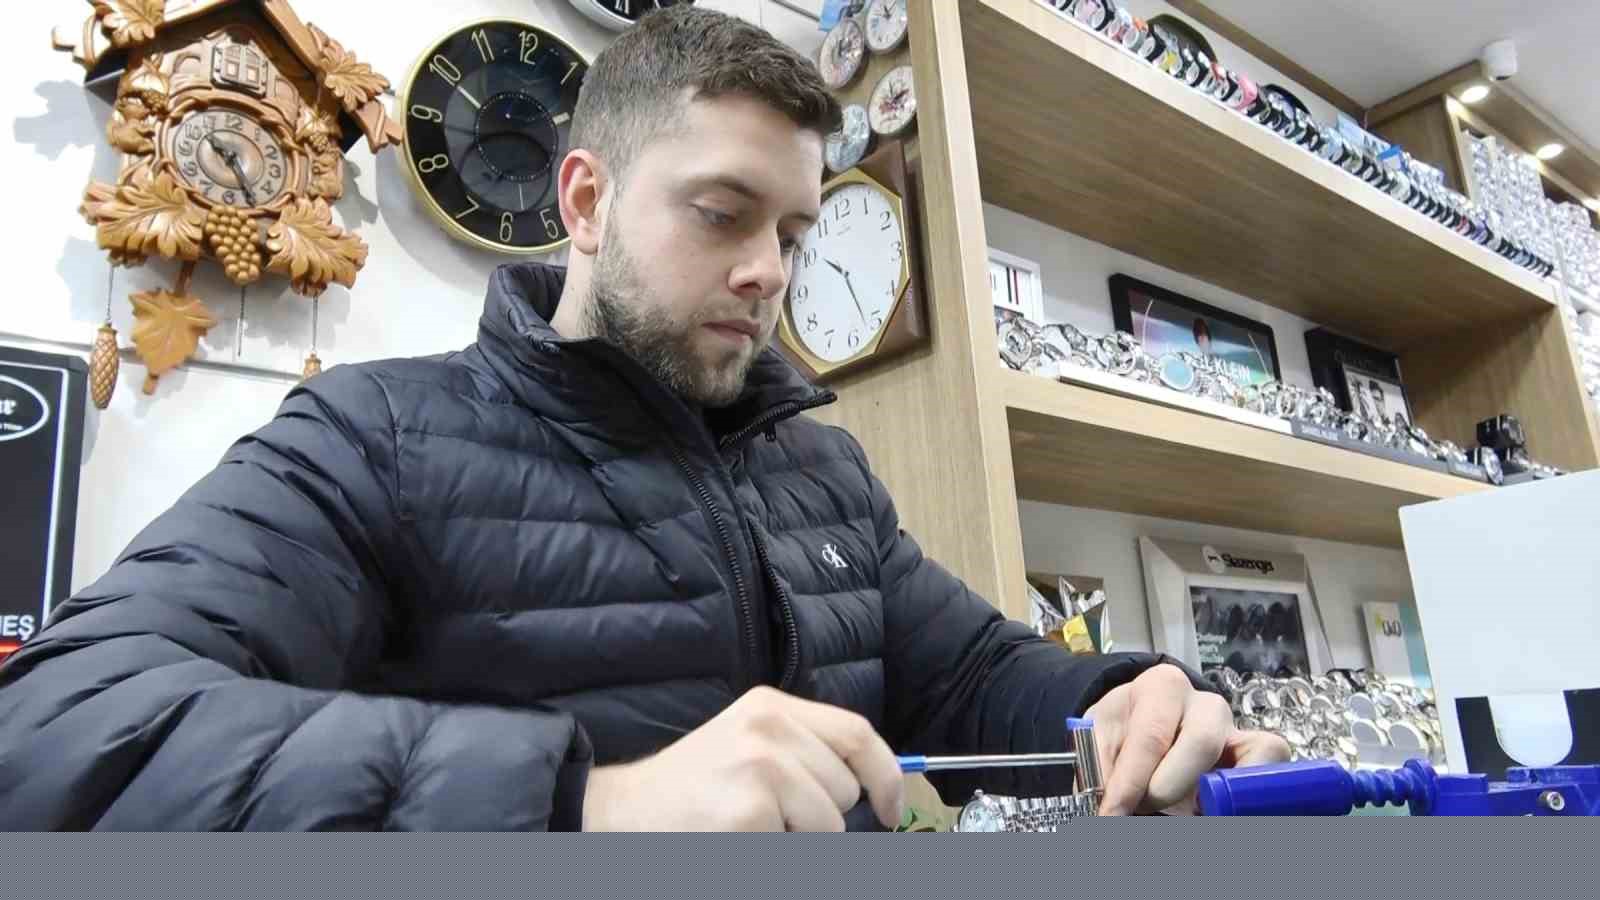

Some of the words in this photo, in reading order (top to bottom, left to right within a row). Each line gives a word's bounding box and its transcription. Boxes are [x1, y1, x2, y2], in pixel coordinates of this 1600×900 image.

[471, 28, 495, 63] 11
[519, 30, 539, 64] 12
[428, 54, 461, 87] 10
[560, 61, 578, 85] 1
[411, 104, 443, 123] 9
[264, 144, 278, 160] 2
[269, 163, 281, 178] 3
[418, 154, 449, 173] 8
[455, 195, 480, 219] 7
[833, 198, 850, 221] 12
[863, 197, 869, 215] 1
[499, 211, 513, 242] 6
[540, 208, 559, 239] 5
[817, 219, 829, 238] 11
[880, 210, 892, 231] 2
[802, 247, 817, 268] 10
[890, 240, 903, 262] 3
[796, 284, 809, 304] 9
[806, 312, 818, 332] 8
[870, 309, 883, 330] 5
[824, 328, 835, 351] 7
[847, 329, 860, 348] 6
[1214, 356, 1251, 383] KLEIN
